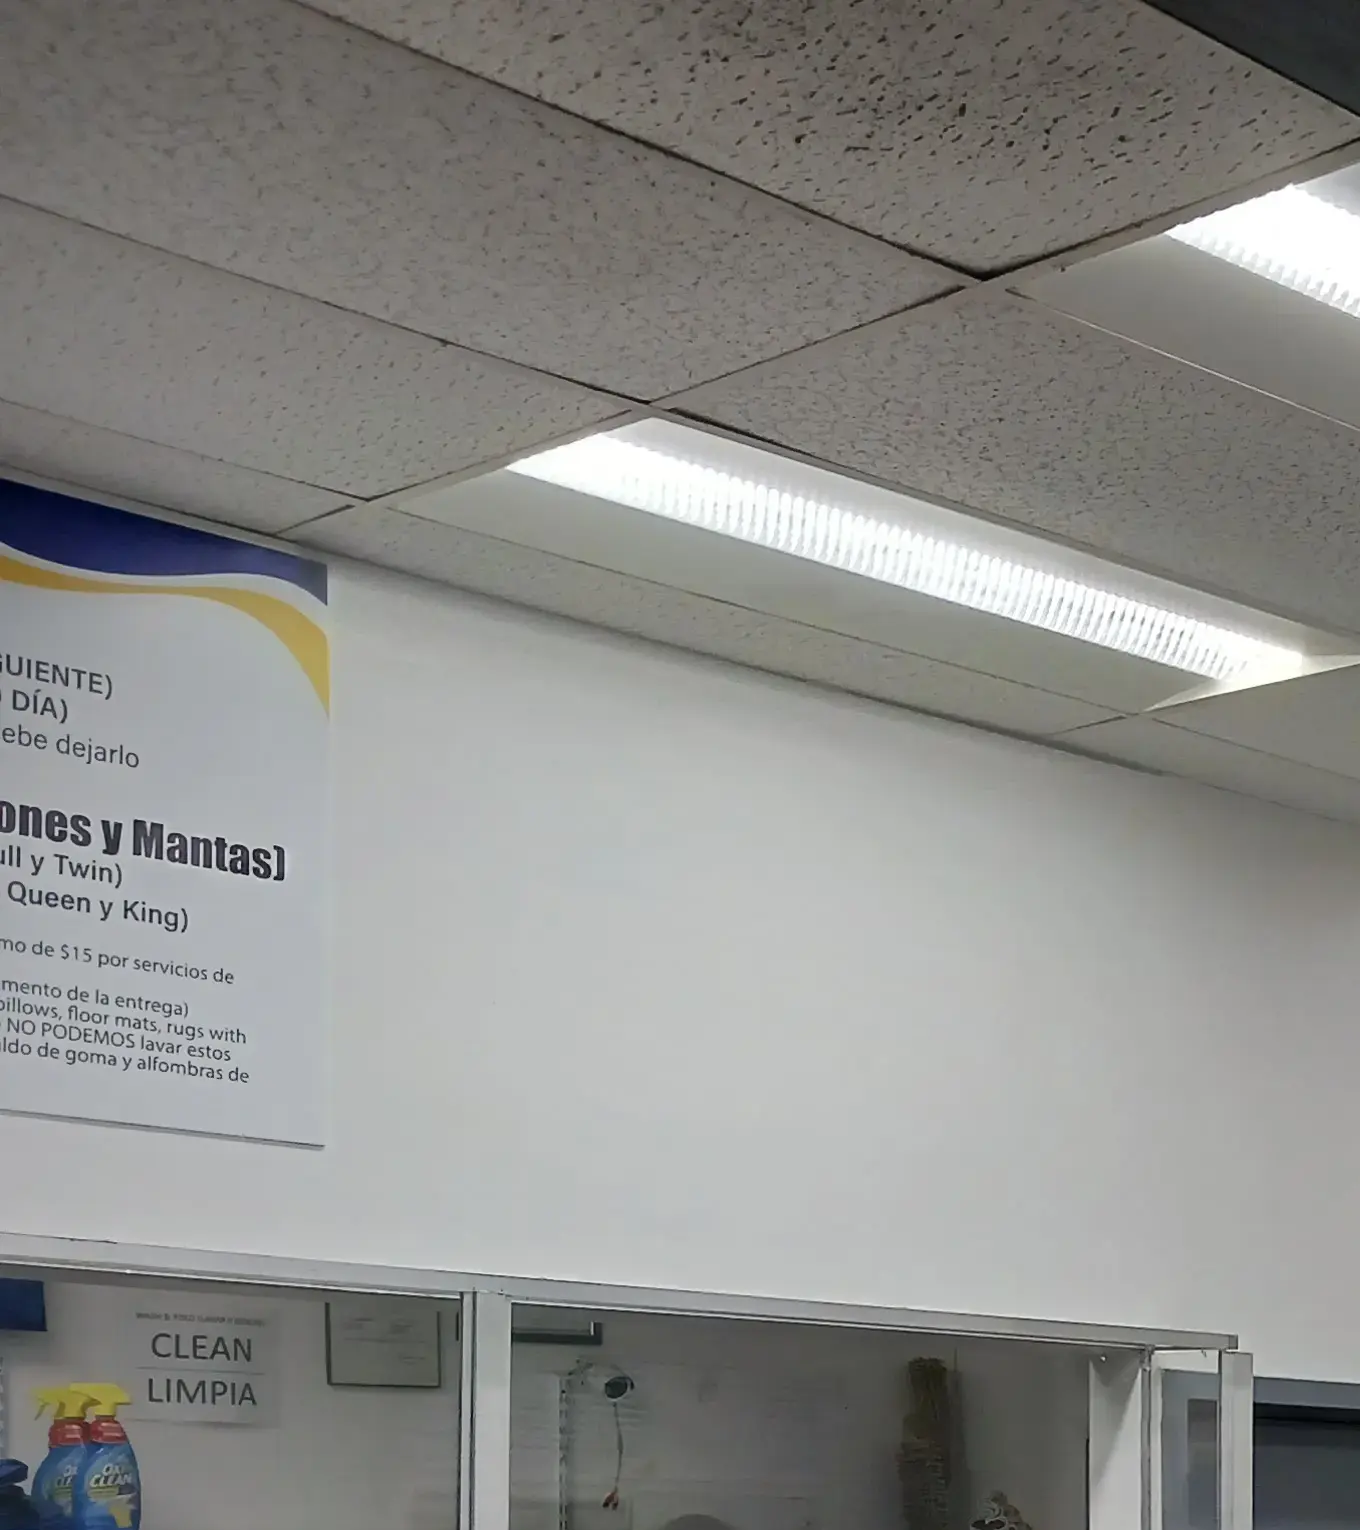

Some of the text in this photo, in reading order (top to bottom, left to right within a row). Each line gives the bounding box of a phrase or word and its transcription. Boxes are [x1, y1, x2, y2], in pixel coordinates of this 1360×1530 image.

[0, 653, 112, 700] UIENTE)
[12, 688, 68, 724] DÍA)
[56, 734, 140, 768] dejarlo
[101, 819, 123, 856] y
[132, 818, 286, 882] Mantas)
[31, 854, 45, 876] y
[54, 853, 123, 889] Twin)
[7, 880, 189, 934] Queen y King)
[31, 940, 55, 958] de
[60, 943, 93, 964] $15
[97, 952, 130, 969] por
[132, 957, 208, 981] servicios
[212, 967, 235, 985] de
[66, 985, 90, 1004] de
[94, 989, 110, 1007] la
[114, 995, 190, 1019] entrega)
[7, 1017, 232, 1062] NO PODEMOS lavar estos
[67, 1004, 110, 1025] floor
[114, 1014, 162, 1034] mats,
[166, 1021, 205, 1042] rugs
[208, 1026, 247, 1045] with
[0, 1036, 251, 1084] ldo de goma y alfombras de
[151, 1332, 252, 1363] CLEAN
[148, 1378, 258, 1407] LIMPIA
